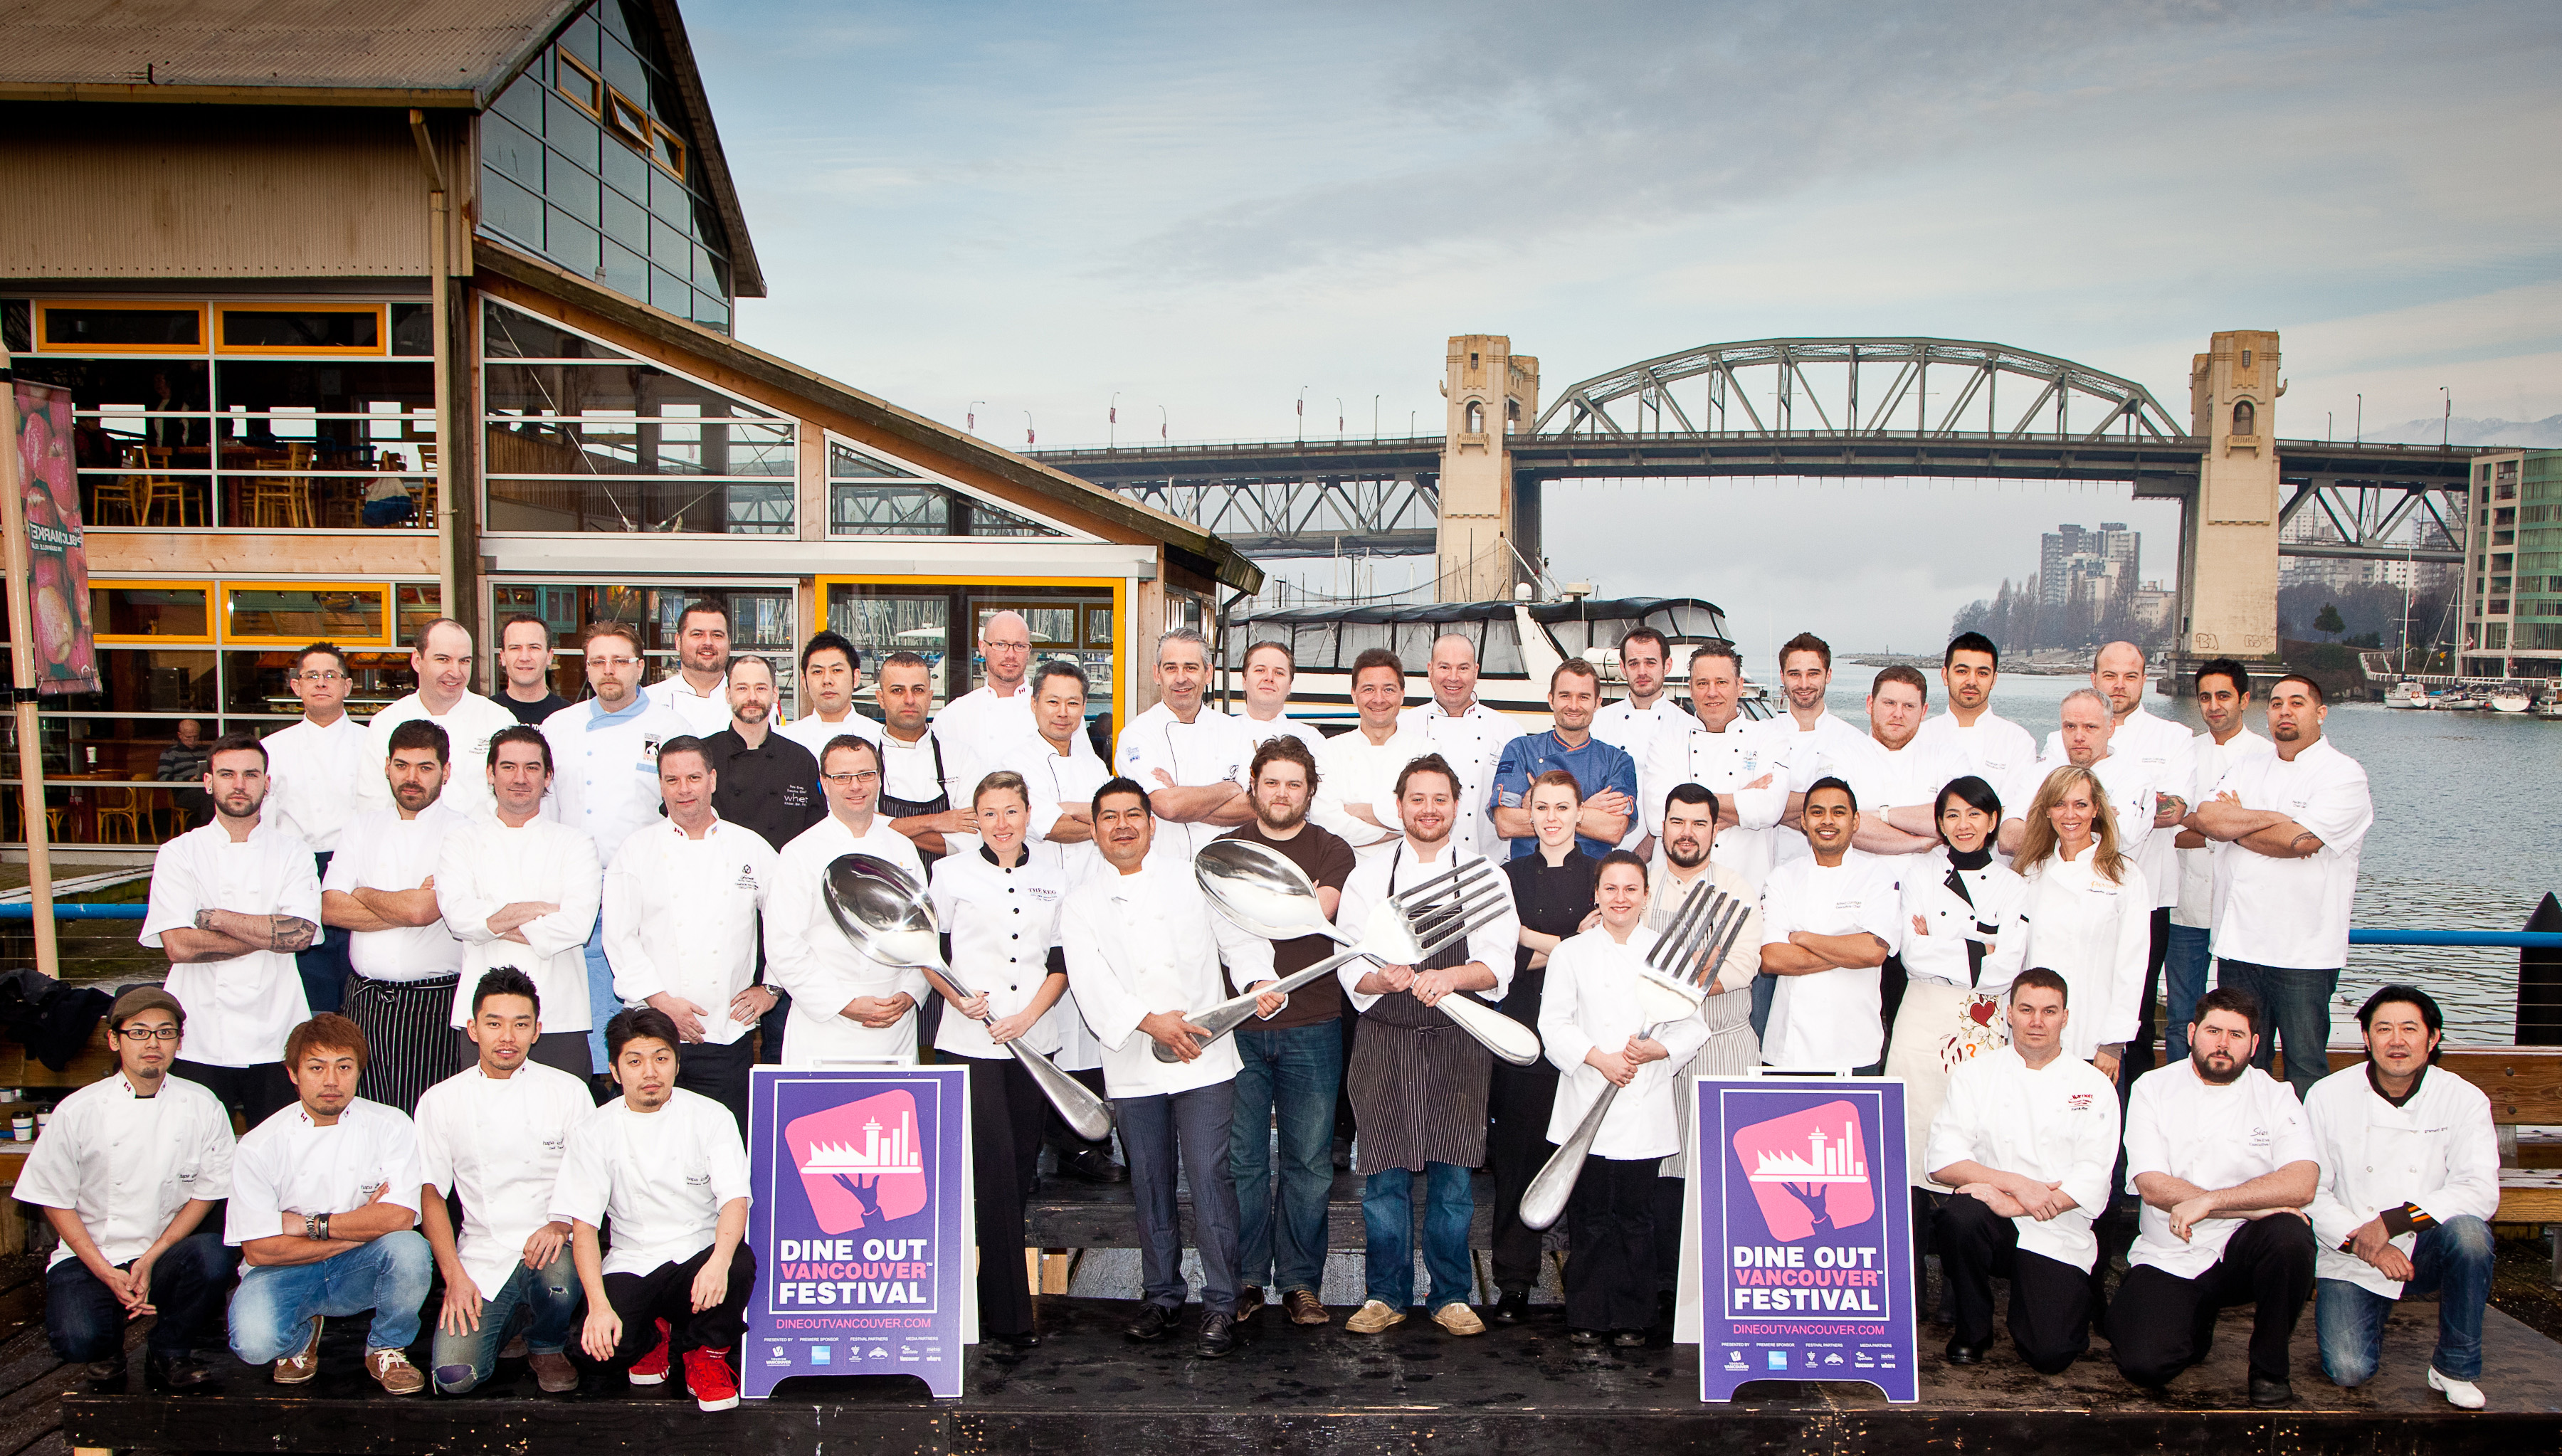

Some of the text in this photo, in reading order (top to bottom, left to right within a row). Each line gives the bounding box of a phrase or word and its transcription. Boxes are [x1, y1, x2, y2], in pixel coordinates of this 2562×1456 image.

[784, 793, 808, 803] whet
[780, 1239, 927, 1261] DINE OUT
[1734, 1246, 1877, 1268] DINE OUT
[781, 1262, 927, 1280] VANCOUVER
[1734, 1269, 1878, 1286] VANCOUVER
[779, 1282, 927, 1304] FESTIVAL
[1734, 1288, 1879, 1311] FESTIVAL
[776, 1318, 931, 1329] DINEOUTVANCOUVER.COM
[1733, 1324, 1884, 1335] DINEOUTVANCOUVER.COM
